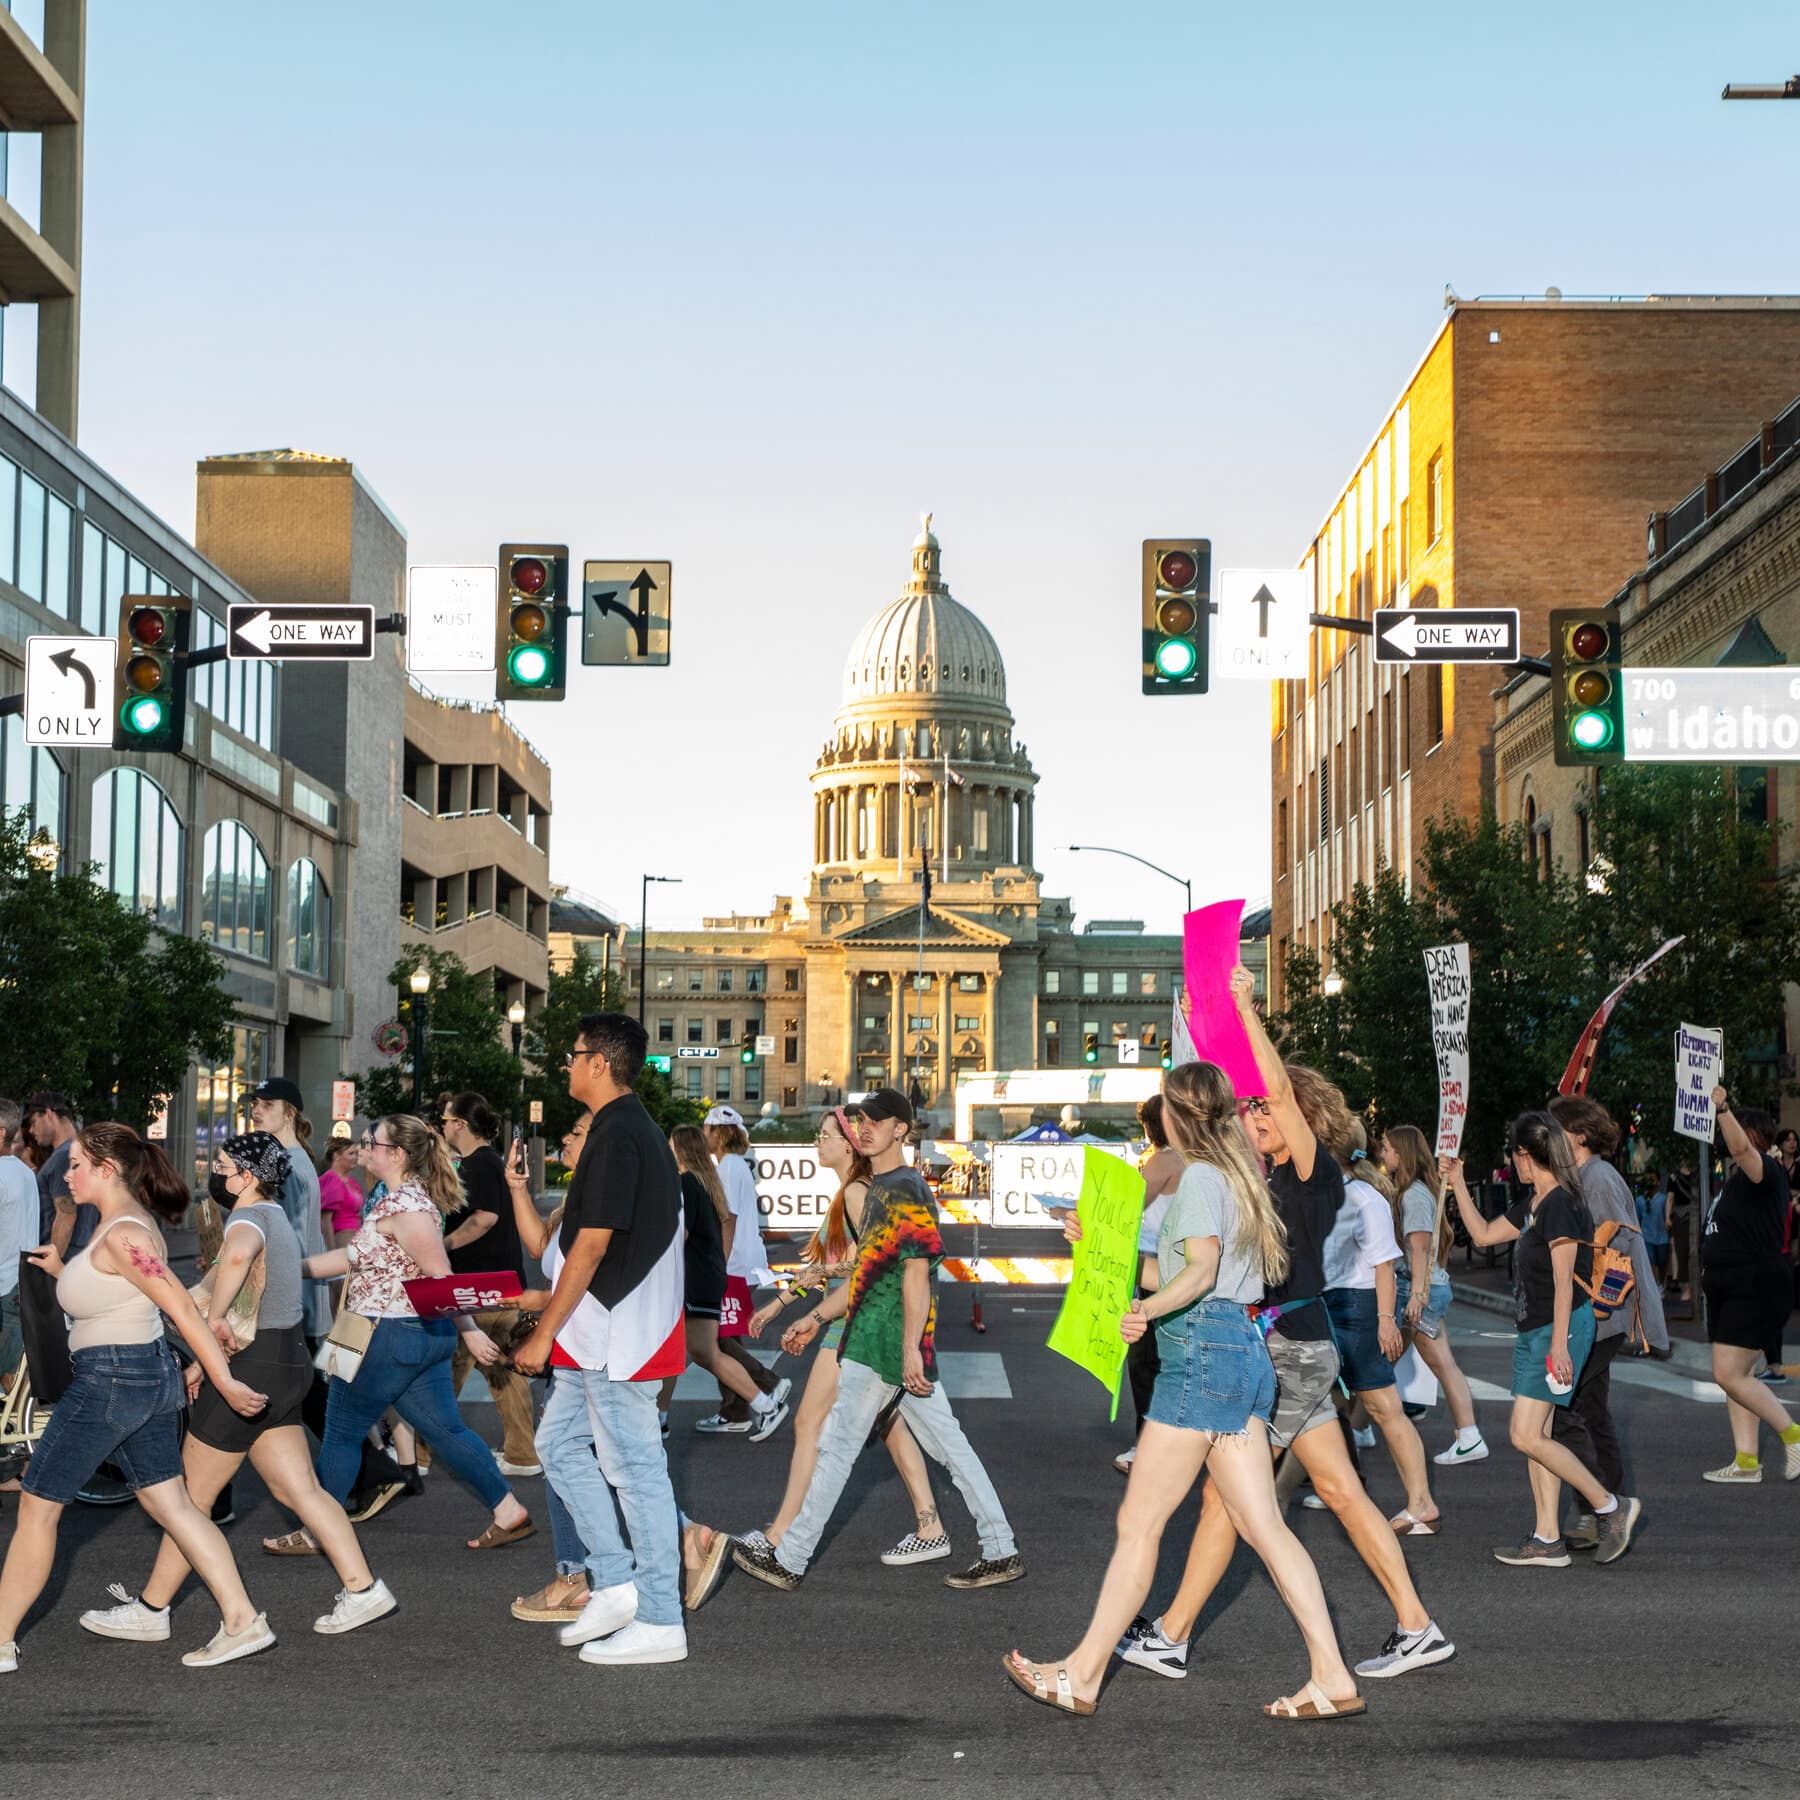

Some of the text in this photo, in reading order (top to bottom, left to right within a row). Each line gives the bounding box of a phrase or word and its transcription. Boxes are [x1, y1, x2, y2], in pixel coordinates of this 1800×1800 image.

[433, 613, 472, 626] MUST
[270, 624, 357, 641] ONE WAY
[1416, 628, 1501, 644] ONE WAY
[1233, 648, 1294, 666] ONLY
[1631, 678, 1677, 701] 700
[38, 717, 102, 736] ONLY
[1667, 705, 1799, 749] Idaho
[1425, 946, 1460, 976] DEAR
[1447, 1000, 1467, 1027] HAVE
[1691, 1073, 1703, 1090] ARE
[1678, 1087, 1709, 1114] HUMAN
[1683, 1112, 1713, 1141] RIGHTS!
[1020, 1156, 1078, 1180] ROA
[756, 1194, 831, 1216] OSED
